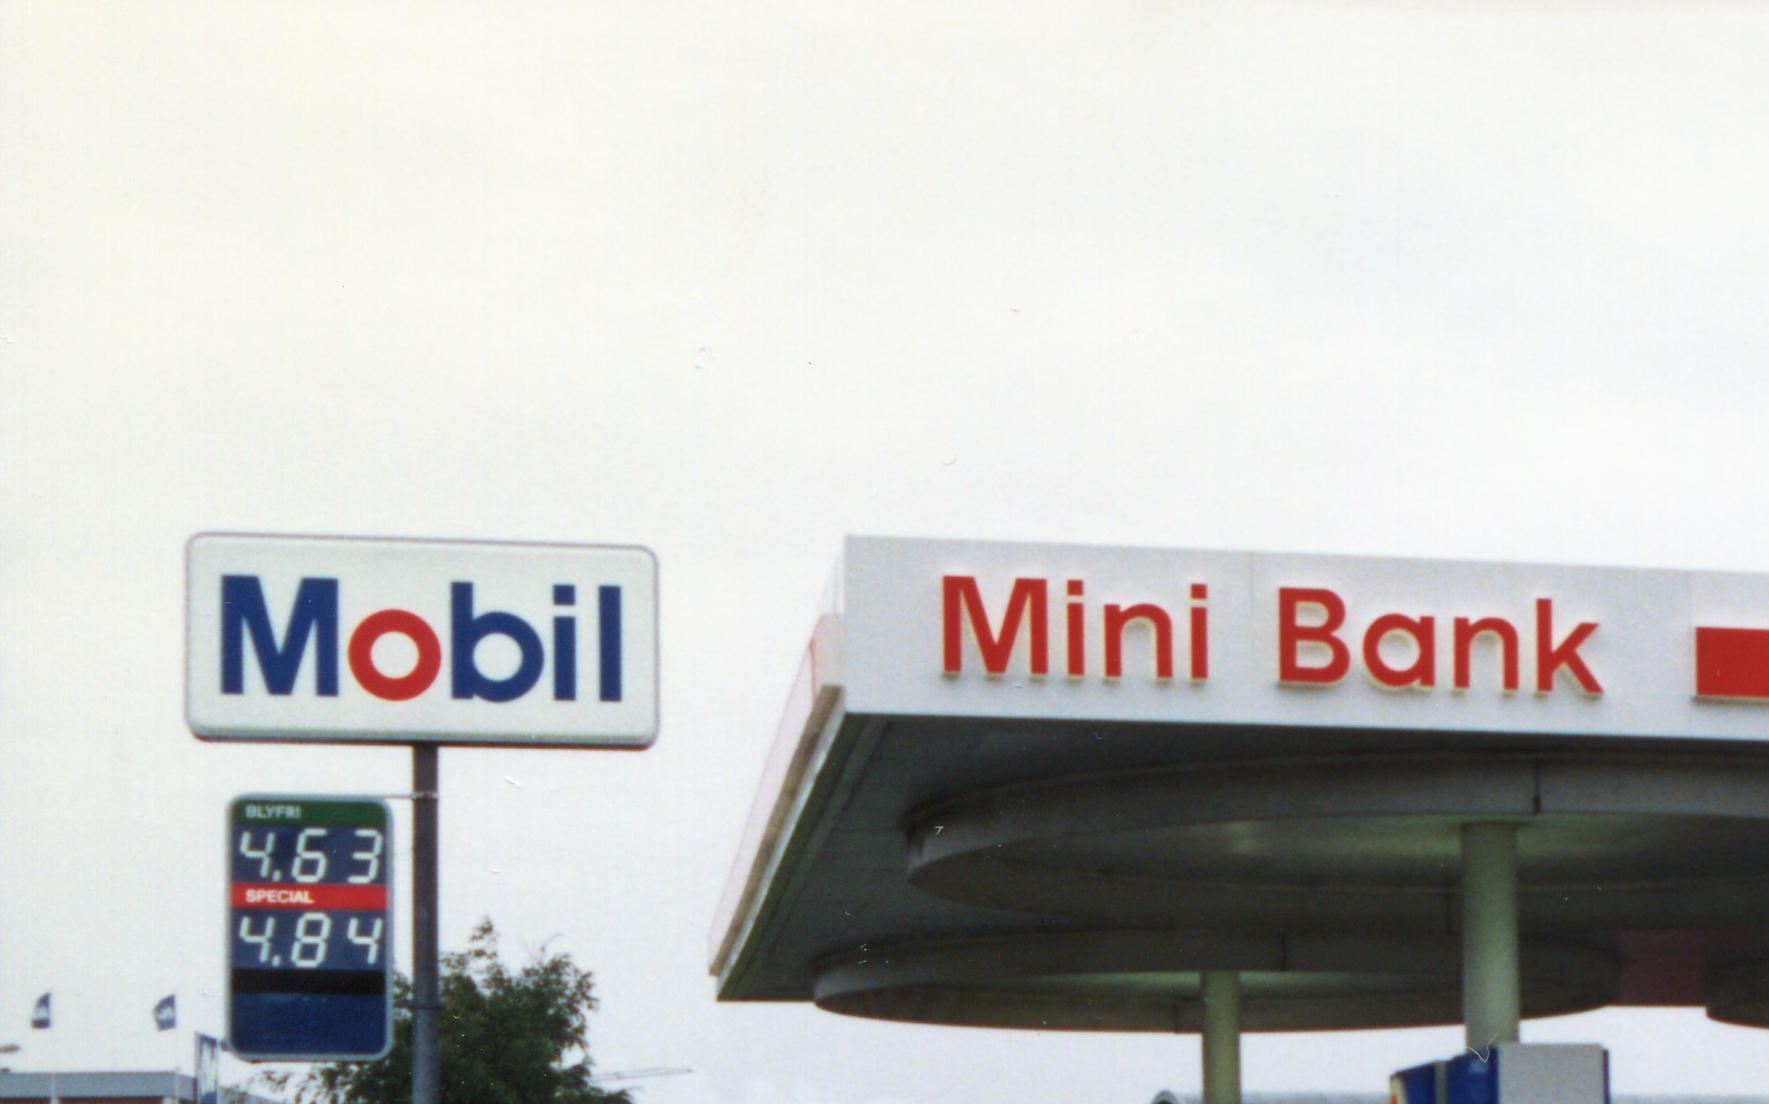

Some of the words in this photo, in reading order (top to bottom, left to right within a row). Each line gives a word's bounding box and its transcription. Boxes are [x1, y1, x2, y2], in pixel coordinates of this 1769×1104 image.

[220, 574, 622, 703] Mobil
[942, 575, 1208, 680] Mini
[1278, 587, 1604, 695] Bank
[246, 805, 302, 819] BLYFRI
[246, 889, 315, 904] SPECIAL
